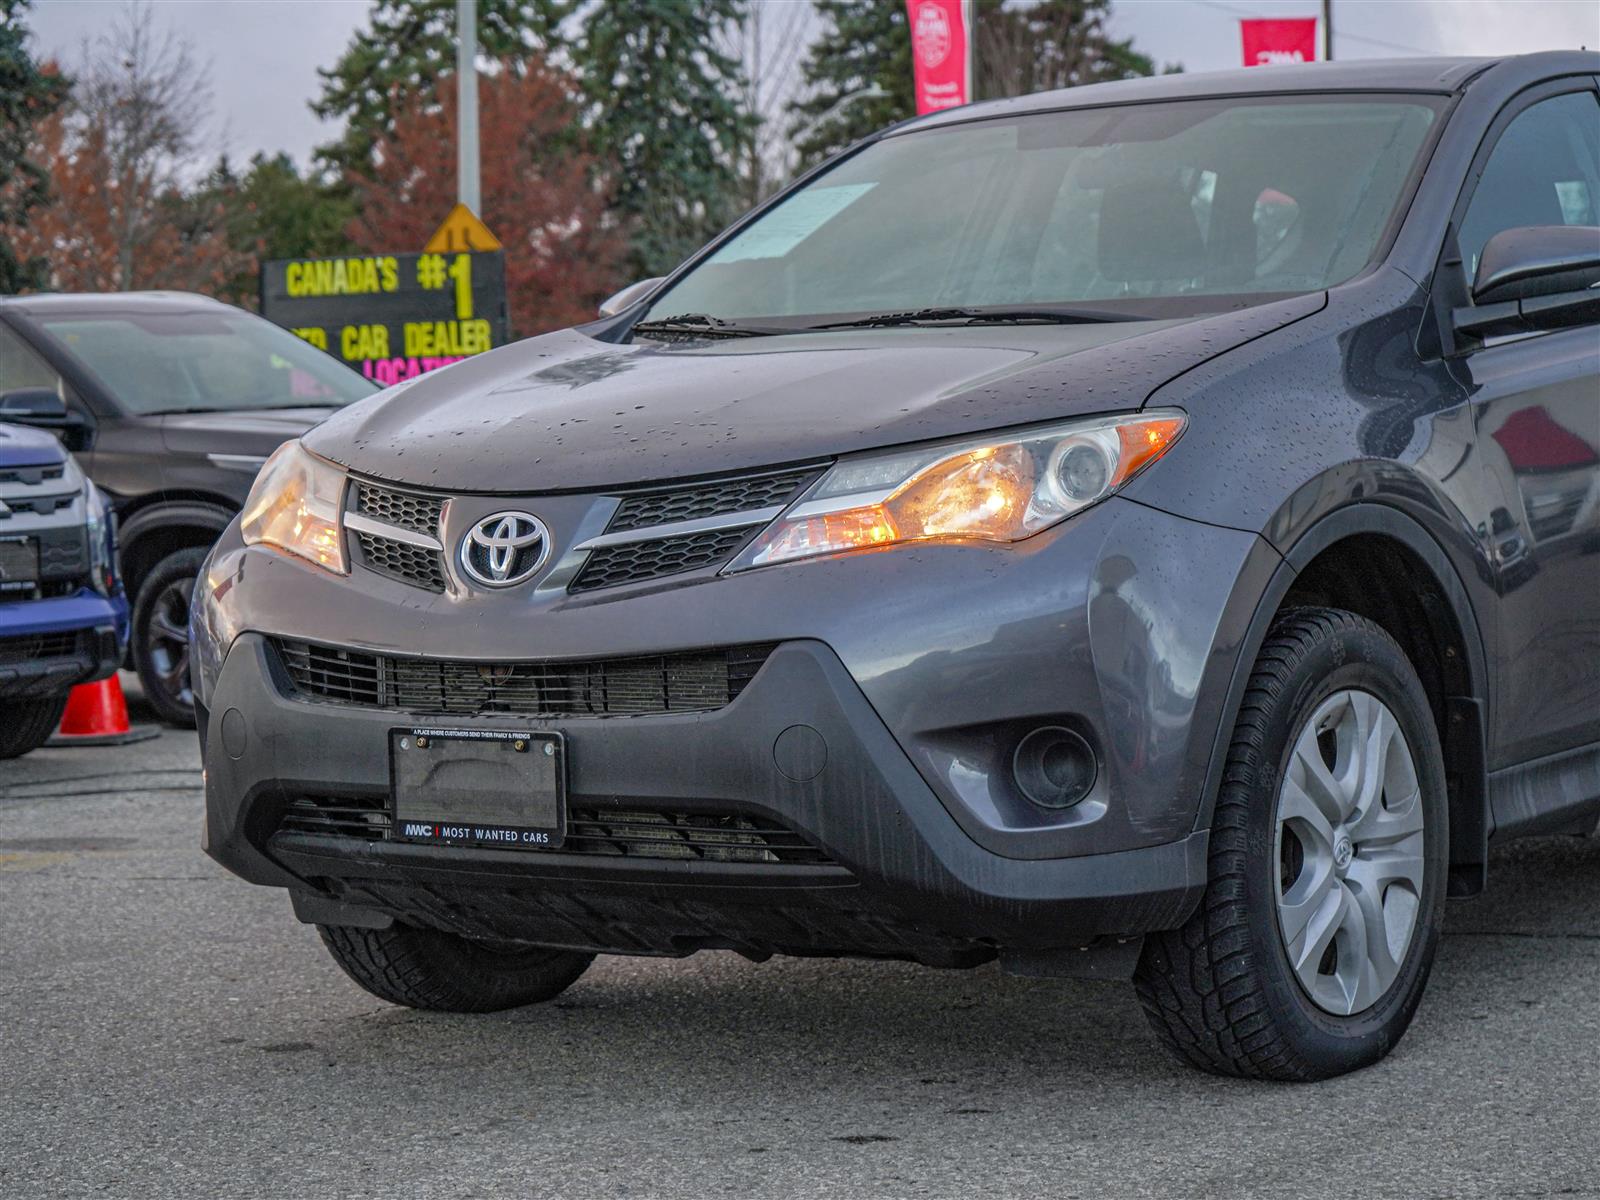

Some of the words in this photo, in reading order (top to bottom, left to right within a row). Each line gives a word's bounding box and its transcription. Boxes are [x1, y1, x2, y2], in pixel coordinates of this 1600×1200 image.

[287, 256, 398, 296] CANADA'S
[417, 254, 472, 319] #1
[341, 324, 389, 360] CAR
[404, 319, 491, 357] DEALER
[442, 826, 470, 838] MOST
[475, 828, 518, 841] WANTED
[523, 831, 549, 843] CARS
